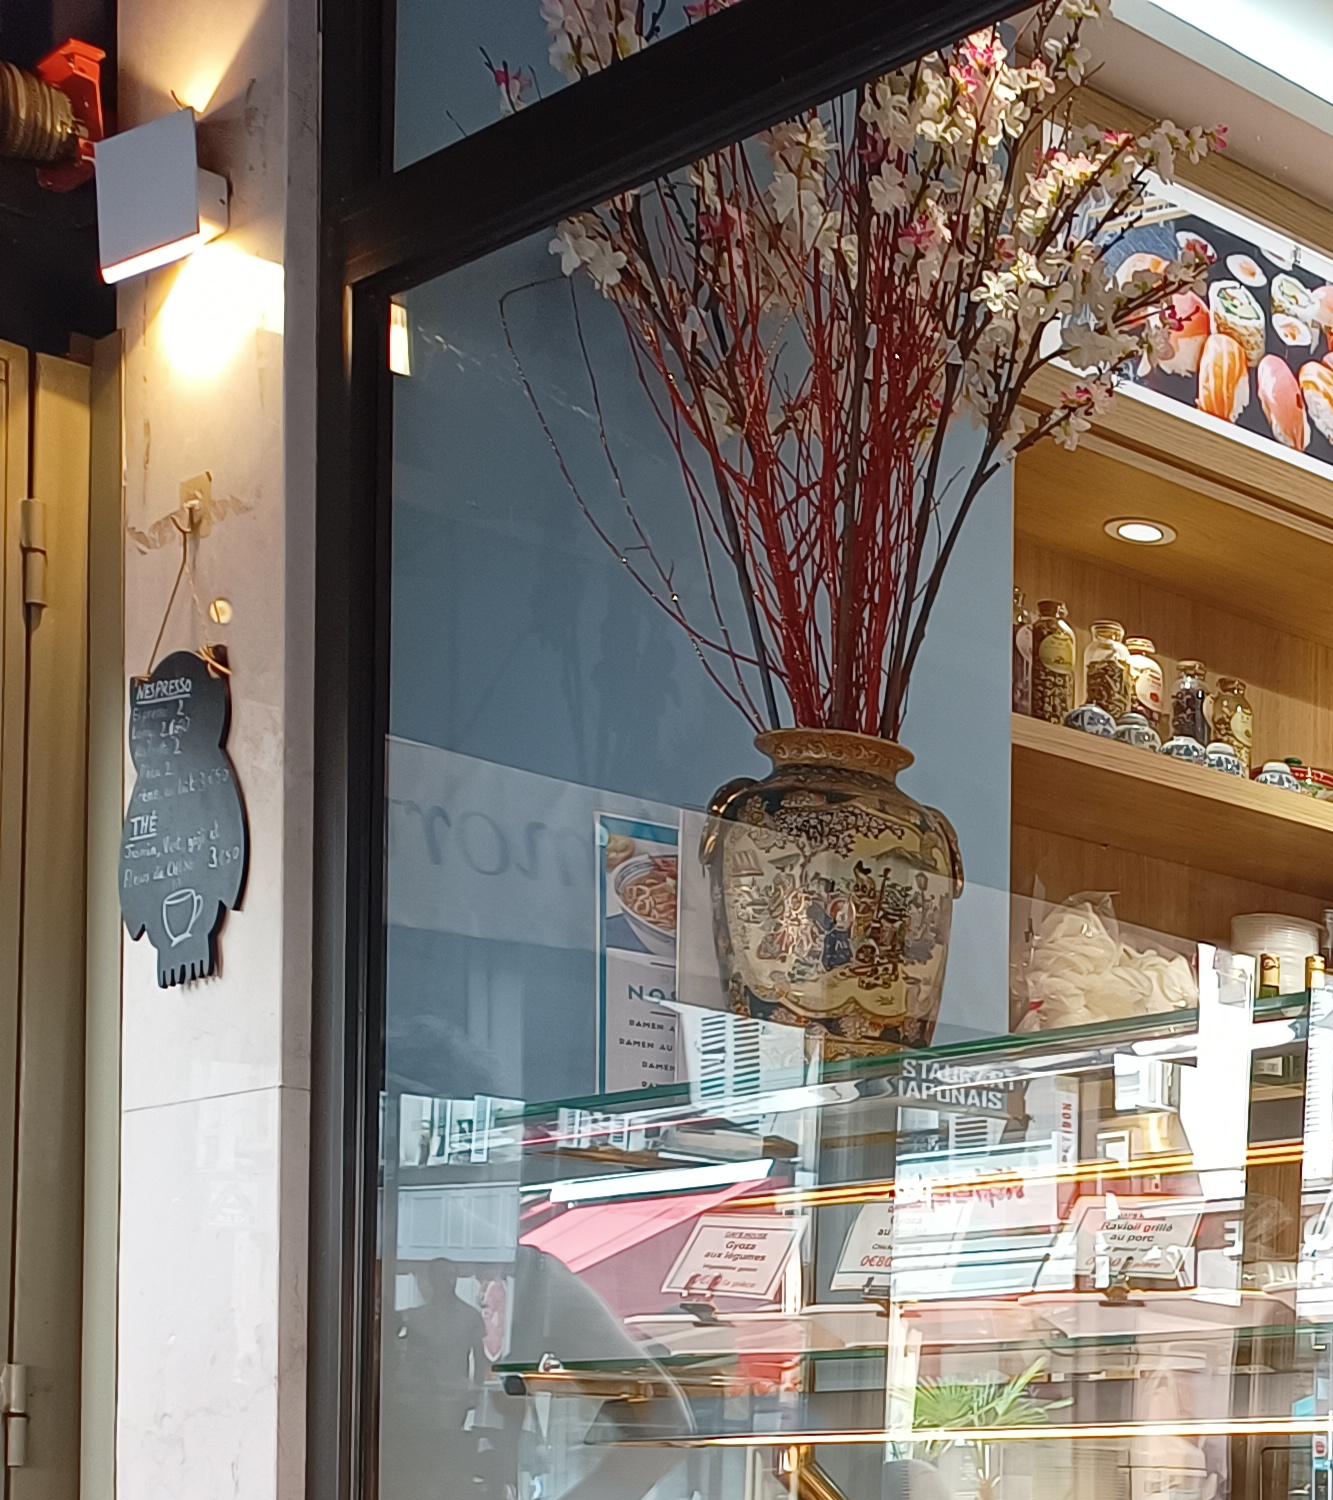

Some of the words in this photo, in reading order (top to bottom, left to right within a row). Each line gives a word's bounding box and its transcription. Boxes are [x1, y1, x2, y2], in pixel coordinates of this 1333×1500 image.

[136, 677, 192, 700] NESPRESSO
[130, 810, 158, 837] THÉ
[629, 1019, 664, 1031] RAMEN
[619, 1037, 655, 1049] RAMEN
[1110, 1233, 1125, 1241] au
[1126, 1234, 1155, 1242] porc
[726, 1241, 757, 1251] Gyoza
[704, 1251, 722, 1259] aux
[724, 1251, 766, 1261] légumes
